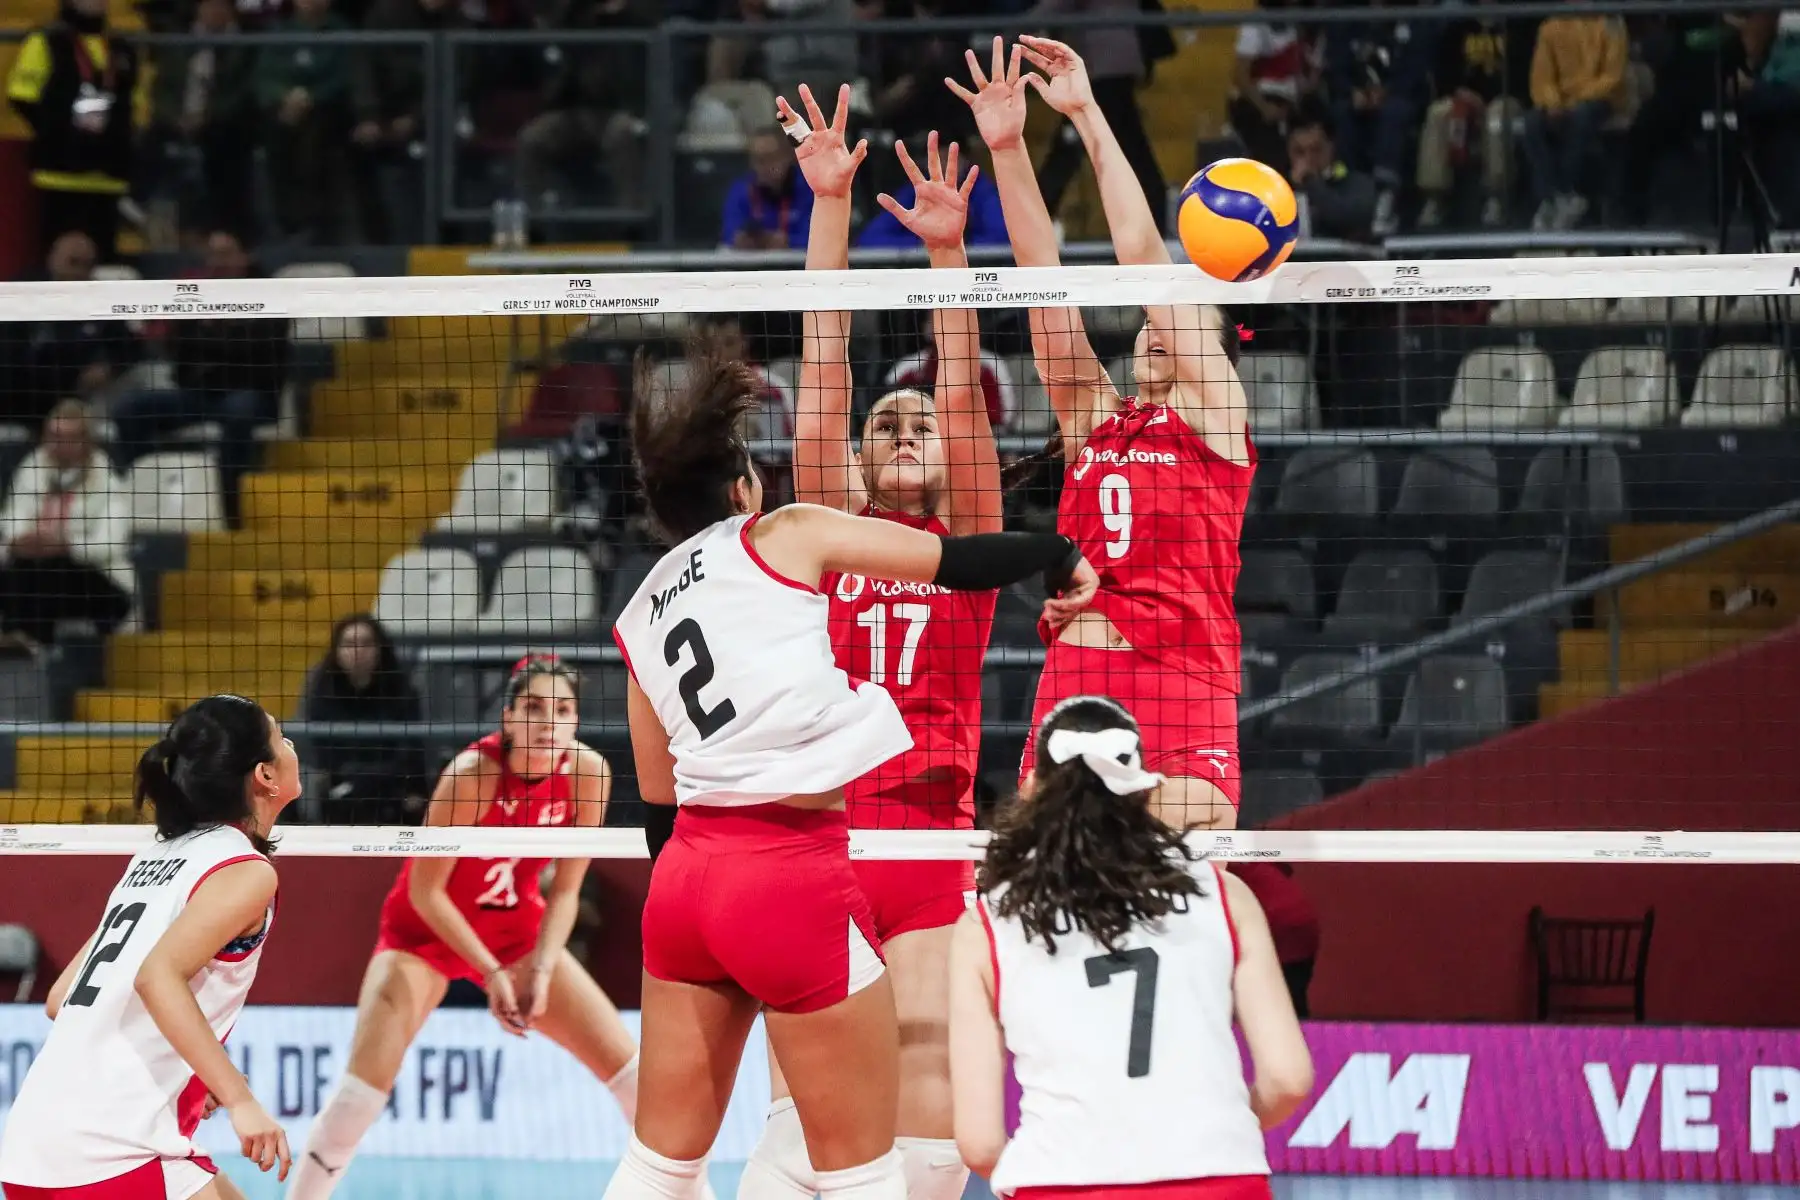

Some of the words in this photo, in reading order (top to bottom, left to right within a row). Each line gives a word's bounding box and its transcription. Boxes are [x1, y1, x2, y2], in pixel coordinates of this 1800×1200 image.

[503, 300, 531, 310] GIRLS'
[534, 300, 550, 309] U17
[555, 299, 587, 309] WORLD
[590, 298, 659, 308] CHAMPIONSHIP
[569, 279, 592, 288] FIVB
[907, 294, 936, 304] GIRLS'
[939, 294, 956, 303] U17
[960, 293, 993, 303] WORLD
[996, 291, 1068, 302] CHAMPIONSHIP
[975, 273, 998, 282] FIVB
[1381, 287, 1415, 296] WORLD
[142, 304, 158, 313] U17
[162, 304, 193, 313] WORLD
[196, 303, 265, 313] CHAMPIONSHIP
[1098, 473, 1133, 559] 9
[857, 602, 931, 686] 17
[663, 617, 737, 741] 2
[122, 858, 188, 888] REBATA
[63, 902, 147, 1008] 12
[1084, 946, 1159, 1078] 7
[417, 1045, 503, 1121] FPV
[1583, 1063, 1719, 1152] VE
